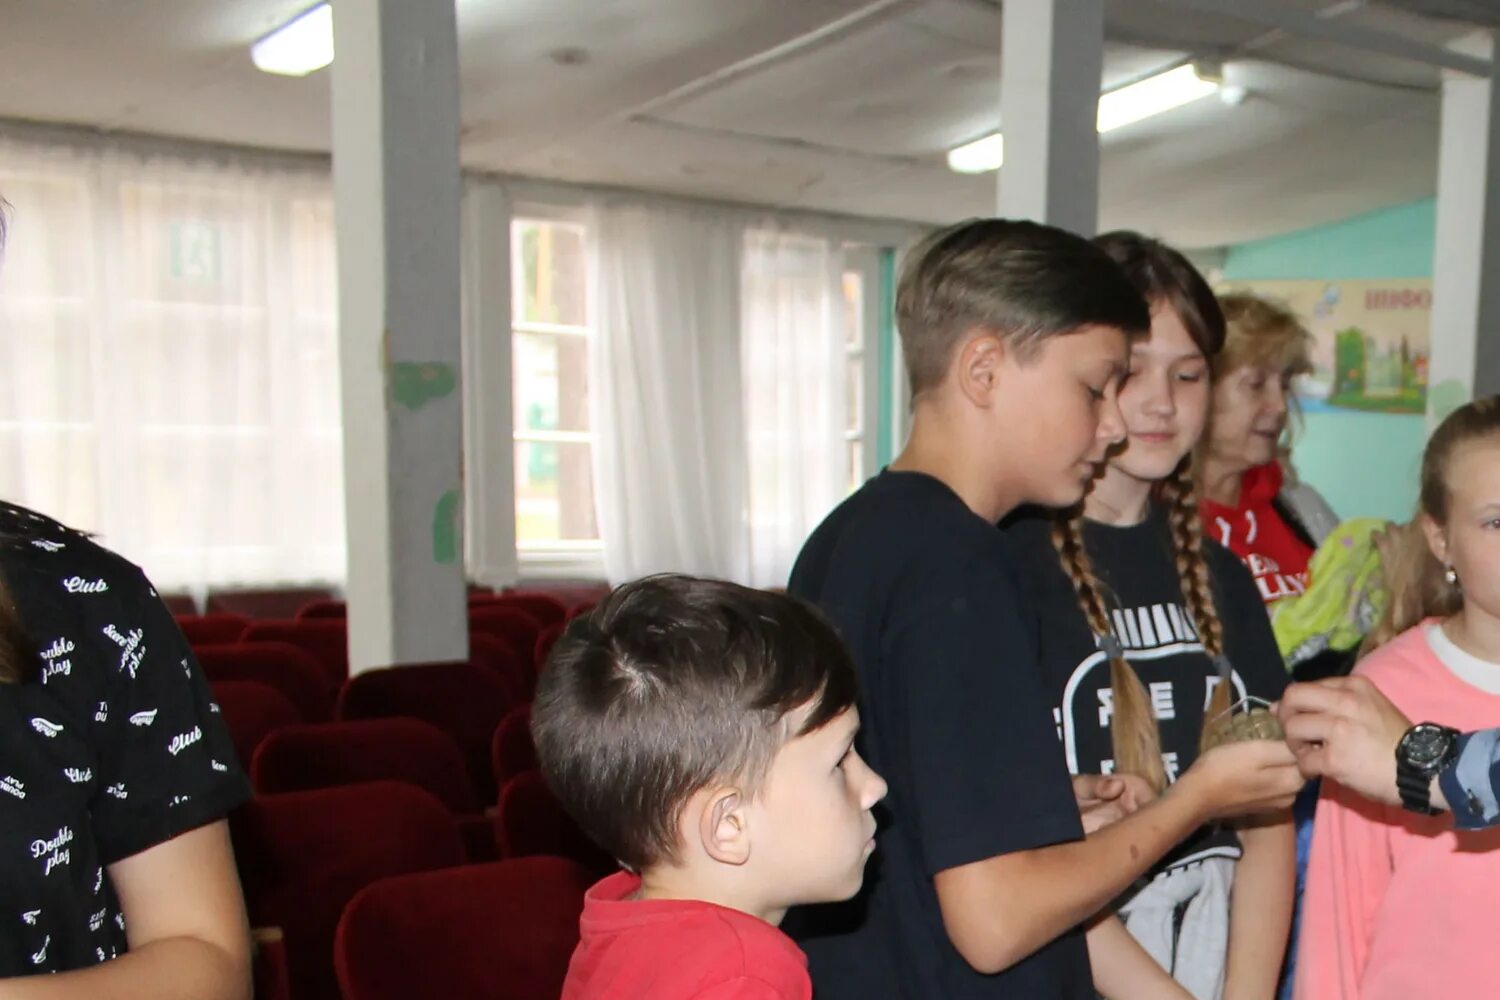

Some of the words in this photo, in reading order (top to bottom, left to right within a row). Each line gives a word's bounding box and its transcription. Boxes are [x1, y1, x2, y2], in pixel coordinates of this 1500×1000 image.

[63, 576, 109, 593] Club
[40, 636, 75, 660] ouble
[168, 725, 202, 756] Club
[31, 826, 73, 858] Double
